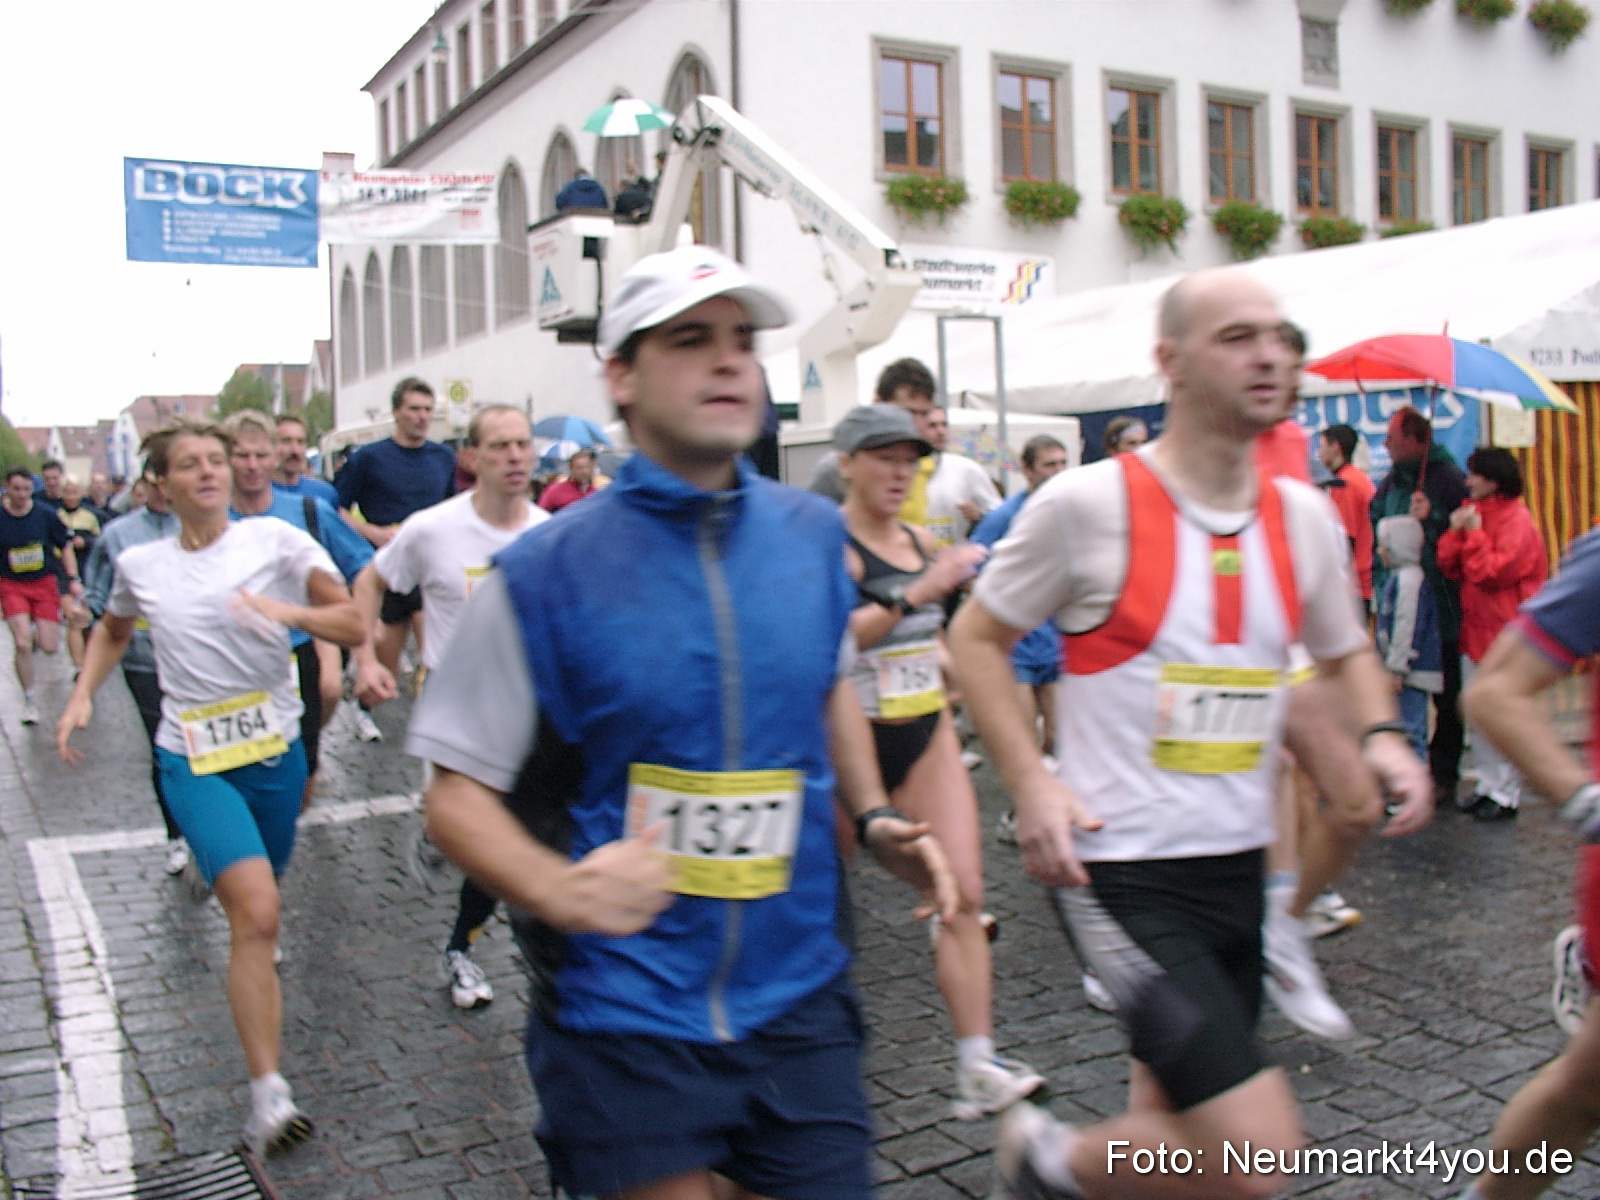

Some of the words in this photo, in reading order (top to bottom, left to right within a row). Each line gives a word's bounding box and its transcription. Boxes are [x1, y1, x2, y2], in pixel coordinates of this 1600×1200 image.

[134, 162, 308, 208] BOCK
[206, 707, 267, 745] 1764
[661, 800, 782, 855] 1327
